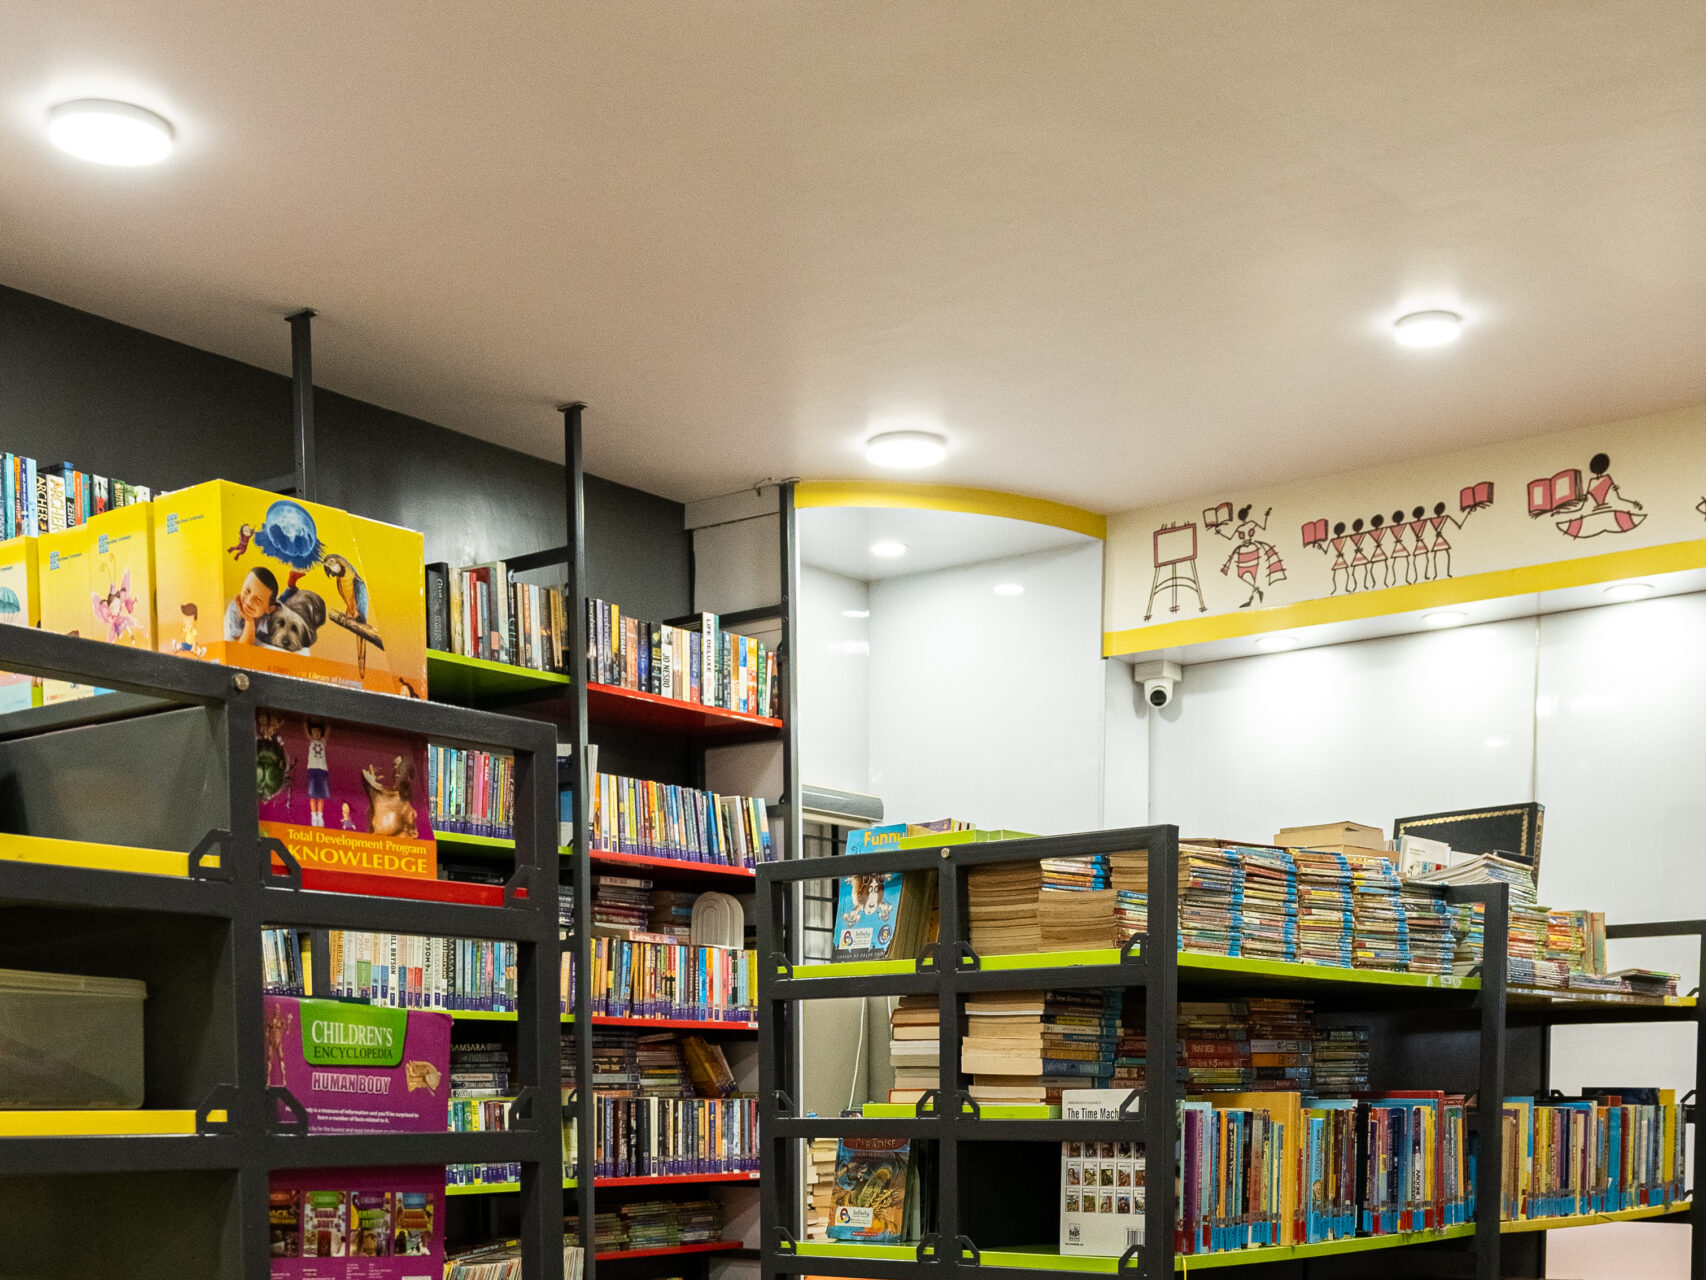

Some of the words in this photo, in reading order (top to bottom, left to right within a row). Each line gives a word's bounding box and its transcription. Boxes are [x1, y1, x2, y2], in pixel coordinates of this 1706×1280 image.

[36, 476, 48, 521] ARCHER
[49, 478, 65, 532] ARCHER
[66, 502, 76, 526] ZERO
[663, 653, 670, 663] JO
[662, 664, 671, 689] NESBO
[287, 829, 313, 841] Total
[316, 832, 383, 850] Development
[385, 840, 427, 855] Program
[287, 844, 427, 874] KNOWLEDGE
[312, 1020, 393, 1047] CHILDREN'S
[313, 1046, 393, 1059] ENCYCLOPEDIA
[450, 1043, 486, 1051] SAMSARA
[312, 1072, 357, 1092] HUMAN
[358, 1076, 391, 1095] BODY
[1067, 1108, 1080, 1119] The
[1081, 1107, 1098, 1119] Time
[1100, 1107, 1120, 1119] Mach
[855, 1137, 896, 1149] PARADISE
